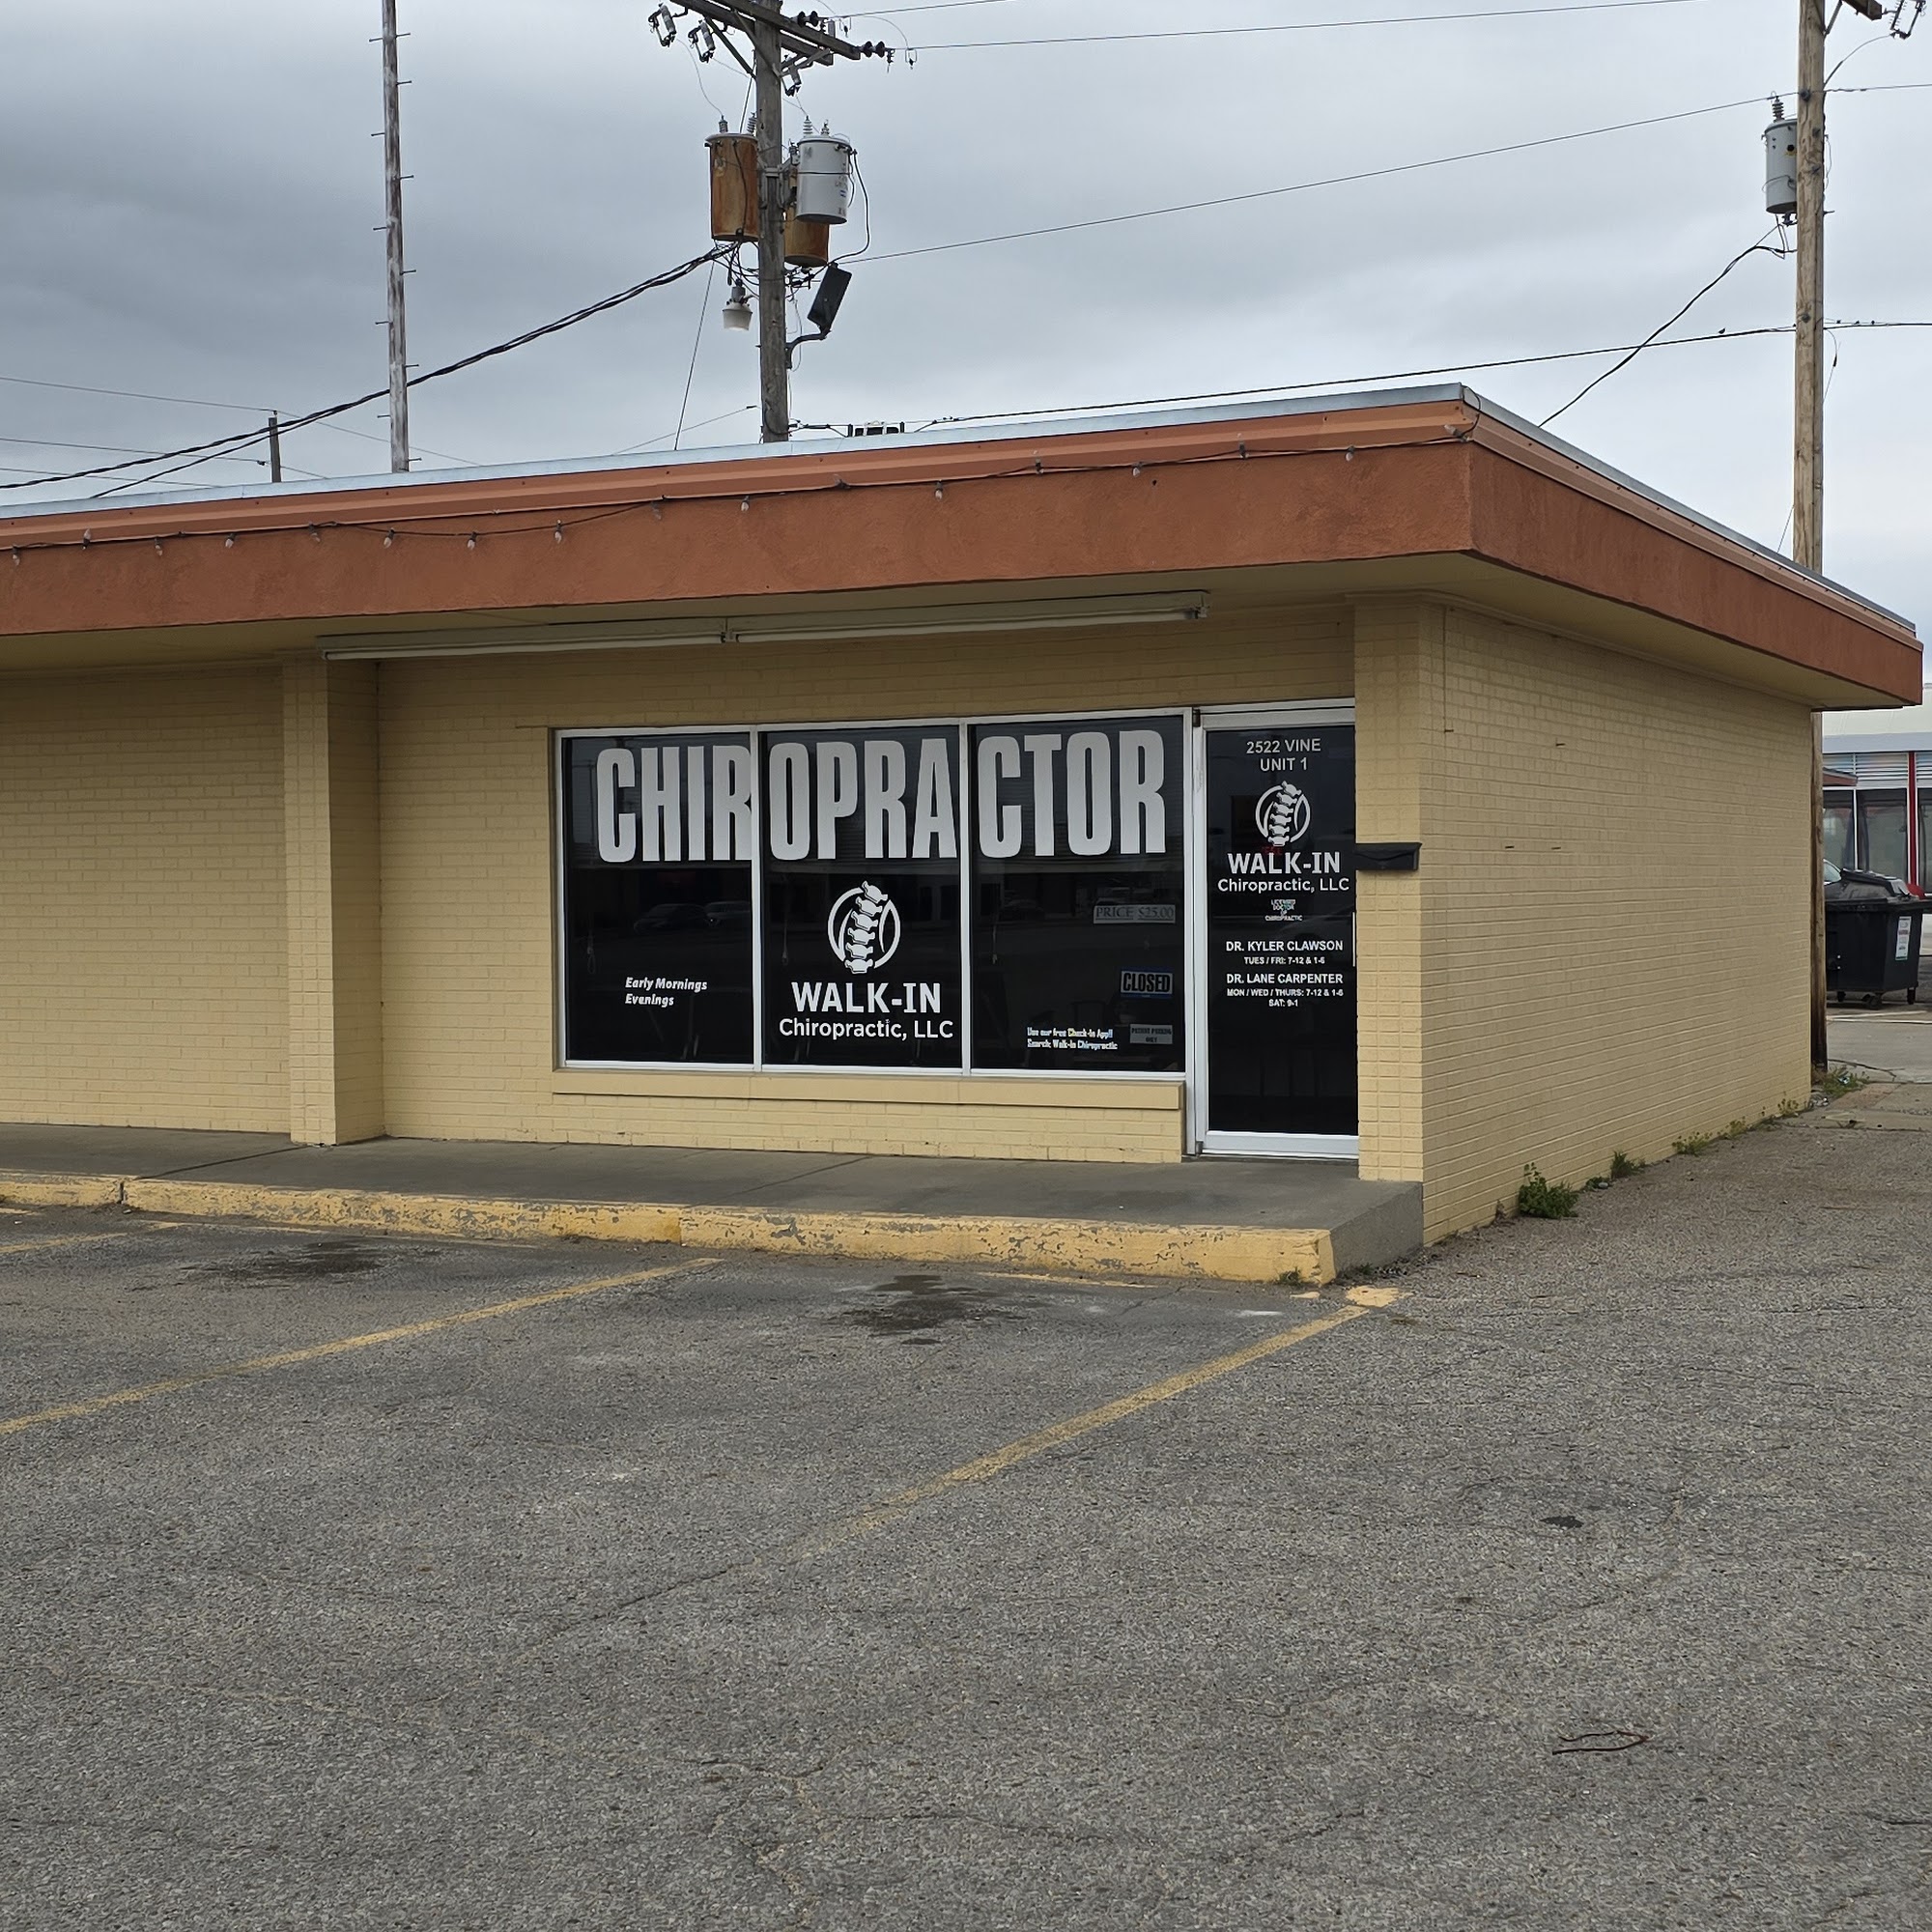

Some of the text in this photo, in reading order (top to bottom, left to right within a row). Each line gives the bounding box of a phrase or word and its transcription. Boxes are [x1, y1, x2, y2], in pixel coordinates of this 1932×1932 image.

[1246, 738, 1321, 753] 2522 VINE
[1260, 757, 1307, 771] UNIT 1
[596, 729, 1166, 863] CHIROPRACTOR
[1227, 851, 1340, 874] WALK-IN
[1217, 877, 1350, 894] Chiropractic, LLC
[1096, 906, 1134, 918] PRICE
[1226, 940, 1344, 952] DR. KYLER CLAWSON
[625, 977, 708, 993] Early Mornings
[1122, 972, 1171, 993] CLOSED
[1226, 974, 1344, 984] DR. LANE CARPENTER
[625, 993, 674, 1008] Evenings
[790, 981, 941, 1013] WALK-IN
[779, 1017, 953, 1040] Chiropractic, LLC
